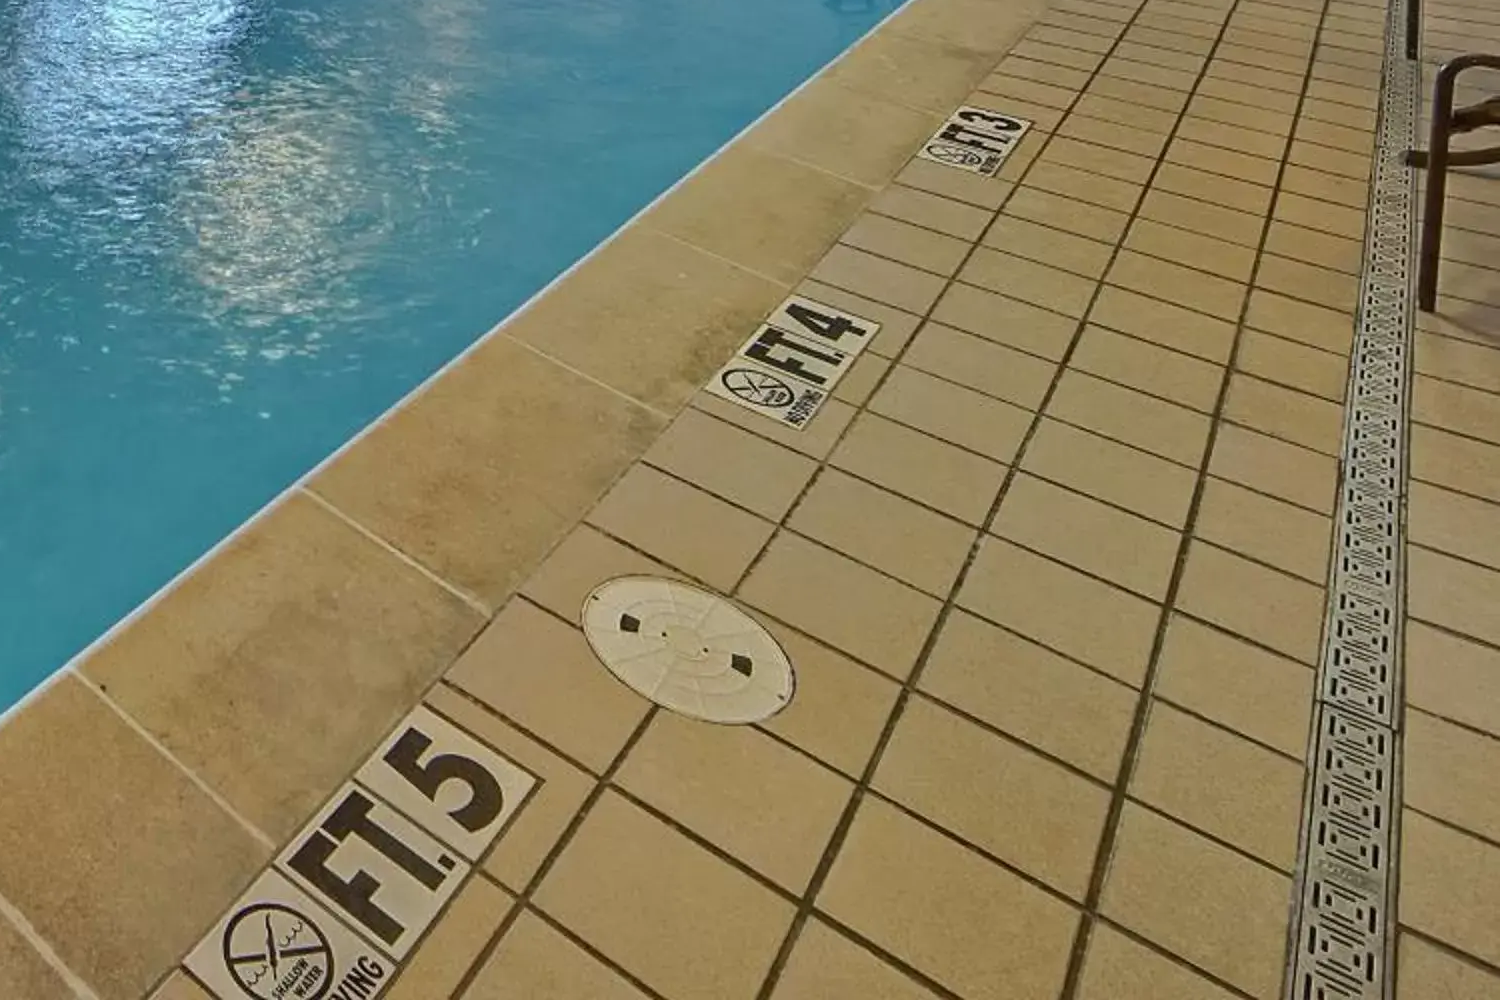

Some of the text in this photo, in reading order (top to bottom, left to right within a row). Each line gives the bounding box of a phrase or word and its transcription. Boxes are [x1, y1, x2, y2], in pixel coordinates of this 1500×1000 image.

[958, 112, 1022, 131] 3
[785, 303, 868, 342] 4
[286, 726, 504, 947] FT. 5
[292, 964, 324, 998] WATER
